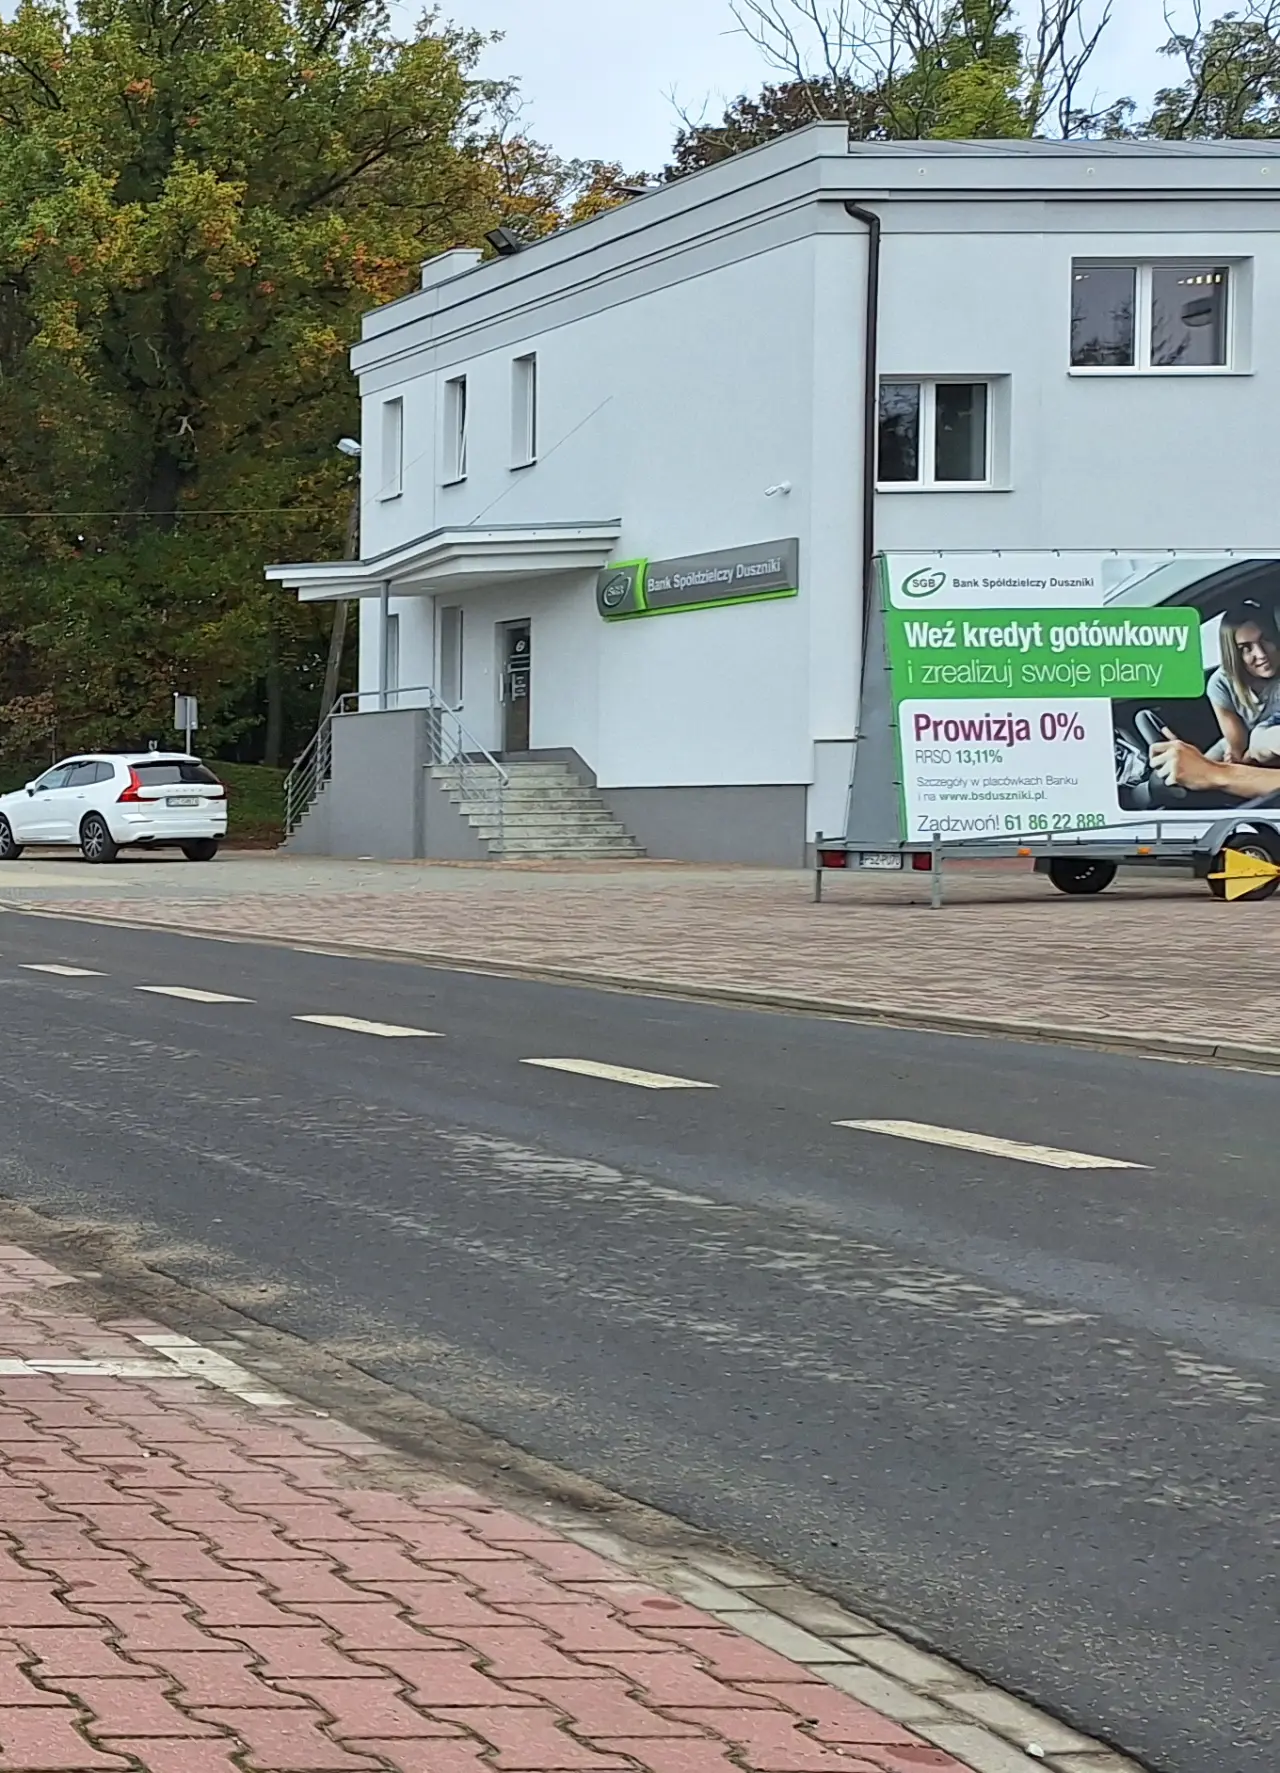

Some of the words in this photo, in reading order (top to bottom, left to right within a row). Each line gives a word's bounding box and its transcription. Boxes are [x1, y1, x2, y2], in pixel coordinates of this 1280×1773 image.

[647, 577, 672, 592] Bank
[673, 567, 734, 590] Spółdzielczy
[736, 557, 781, 579] Duszniki
[912, 578, 936, 588] SGB
[952, 578, 979, 588] Bank
[982, 577, 1047, 591] Spółdzielczy
[1049, 577, 1094, 588] Duszniki
[904, 620, 956, 648] Weź
[963, 621, 1043, 653] kredyt
[1049, 619, 1189, 653] gotówkowy
[907, 660, 913, 683] i
[920, 660, 1013, 688] zrealizuj
[1021, 663, 1091, 688] swoje
[1100, 659, 1163, 687] plany
[914, 713, 1031, 747] Prowizja
[1039, 712, 1085, 741] 0%
[915, 750, 952, 764] RRSO
[955, 749, 1004, 766] 13,11%
[916, 776, 968, 788] Szczegóły
[971, 778, 980, 786] w
[982, 776, 1043, 787] placówkach
[1045, 775, 1078, 786] Banku
[923, 793, 936, 801] na
[917, 815, 1000, 832] Zadzwoń!
[1004, 815, 1023, 831] 61
[1028, 815, 1048, 830] 86
[1052, 814, 1072, 830] 22
[1076, 813, 1106, 829] 888
